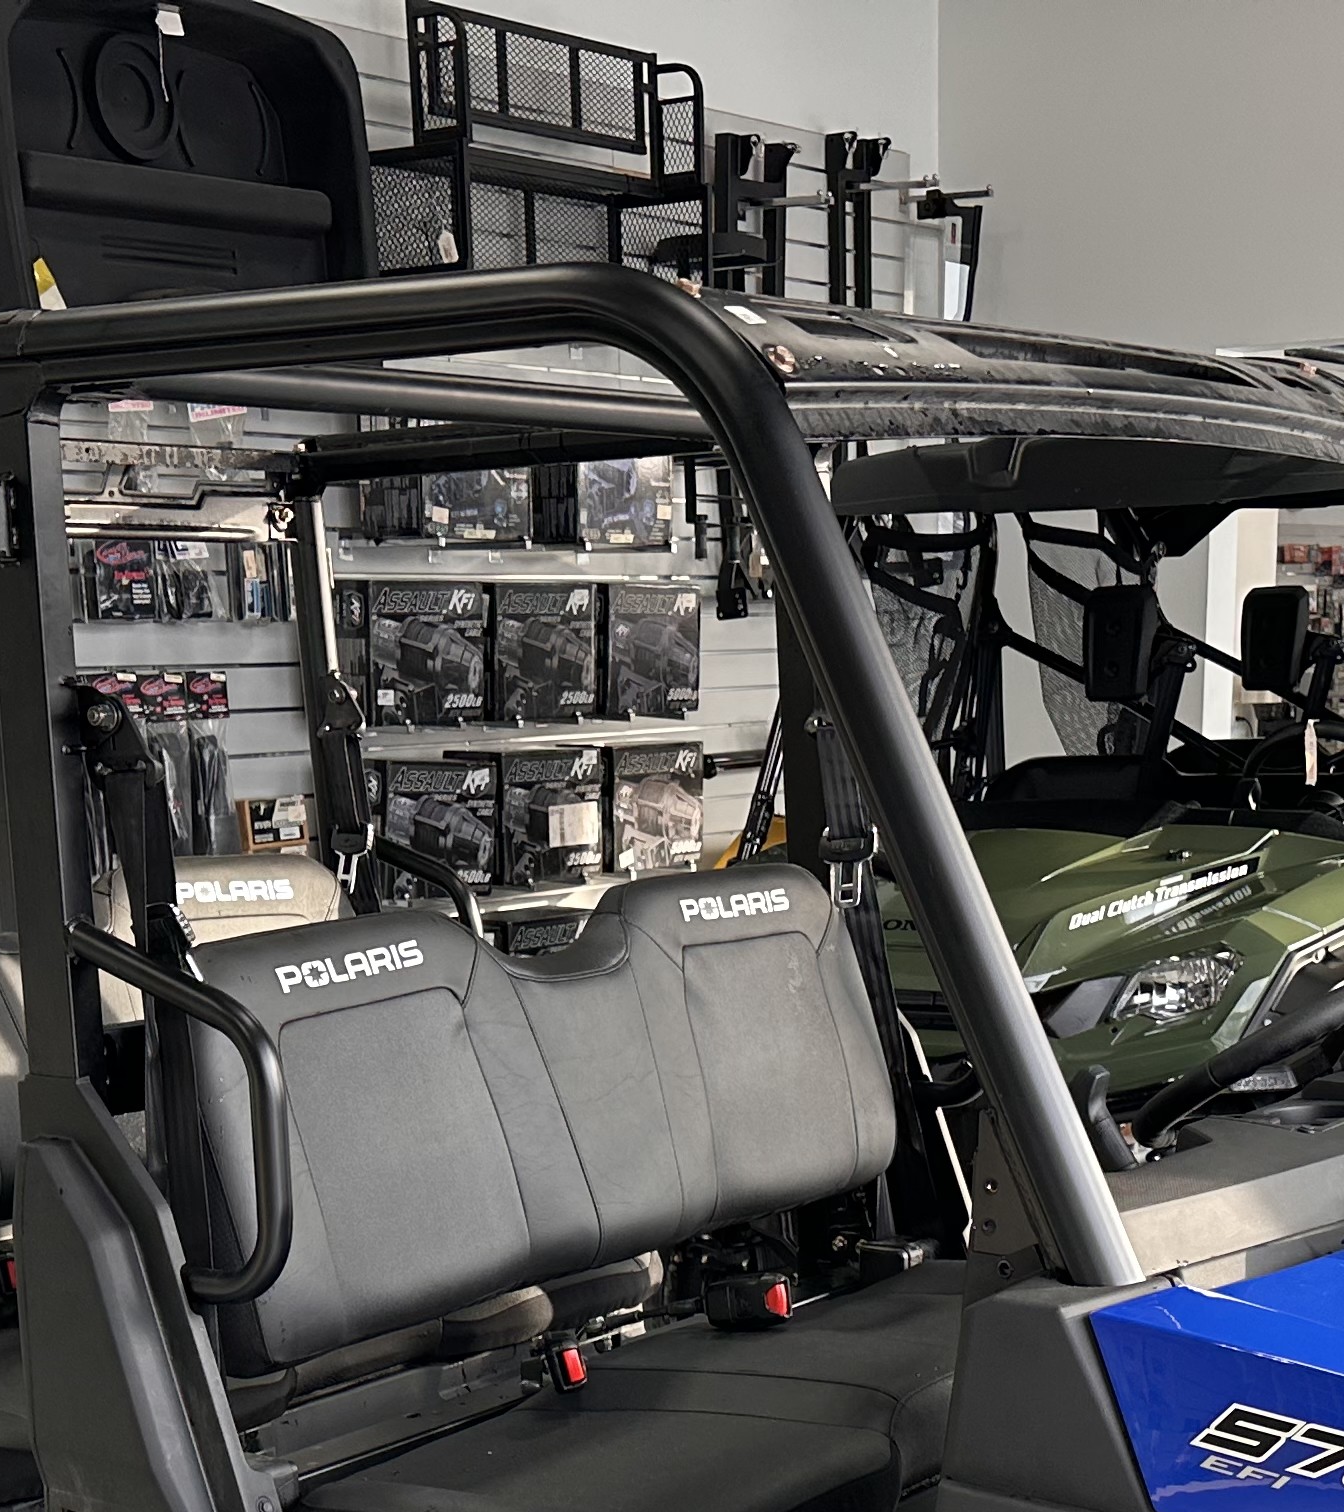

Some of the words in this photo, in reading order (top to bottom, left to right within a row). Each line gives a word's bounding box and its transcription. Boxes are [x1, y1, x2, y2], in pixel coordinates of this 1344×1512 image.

[372, 587, 451, 614] ASSAULT
[389, 766, 466, 792] ASSAULT
[175, 878, 295, 905] POLARIS
[679, 887, 790, 922] POLARIS
[1068, 905, 1106, 931] Dual
[1106, 890, 1155, 918] Clutch
[1155, 863, 1249, 902] Transmission
[274, 940, 424, 994] POLARIS
[1199, 1454, 1292, 1490] EFI
